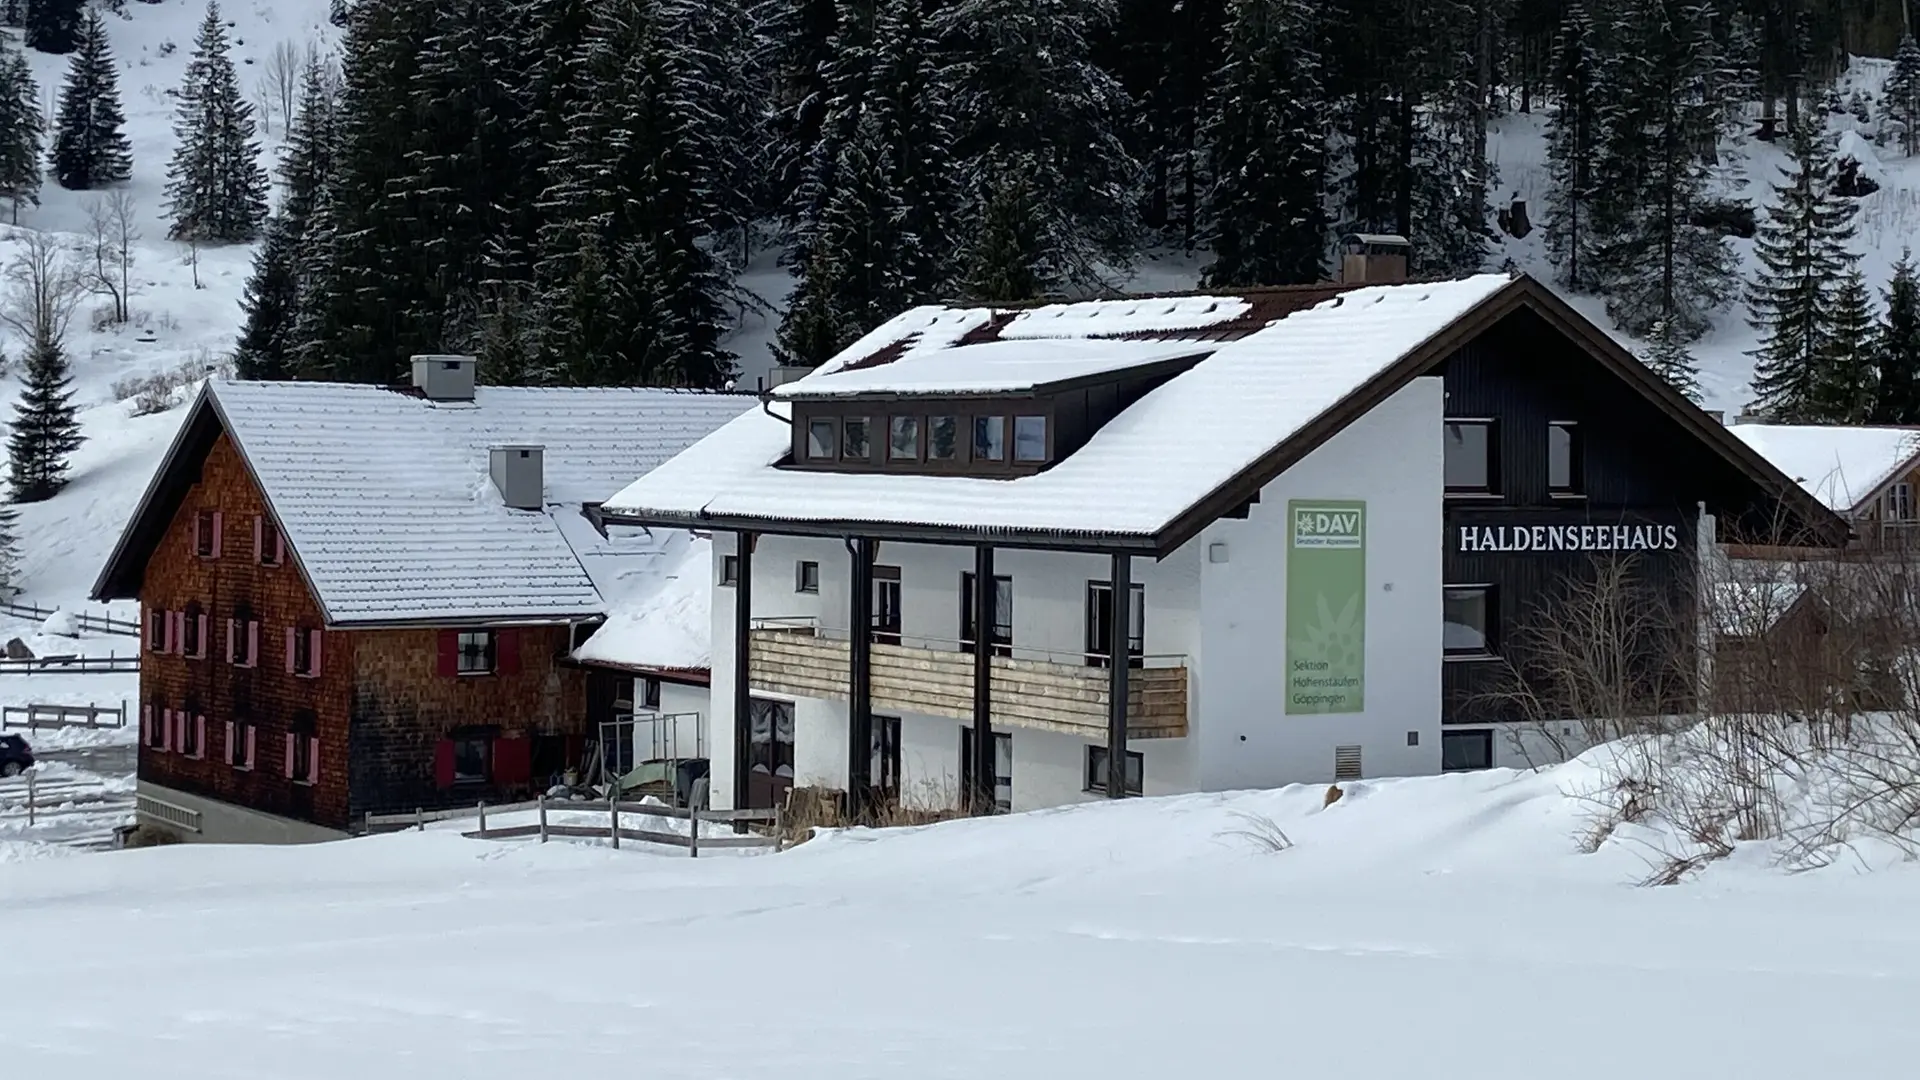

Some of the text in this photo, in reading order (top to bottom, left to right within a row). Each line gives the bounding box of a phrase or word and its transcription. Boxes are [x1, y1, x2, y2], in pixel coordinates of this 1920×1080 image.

[1316, 513, 1357, 534] DAV
[1460, 525, 1678, 551] HALDENSEEHAUS
[1294, 660, 1329, 671] Sektion
[1293, 676, 1359, 687] Hohenstaufen
[1293, 692, 1346, 706] Göppingen
